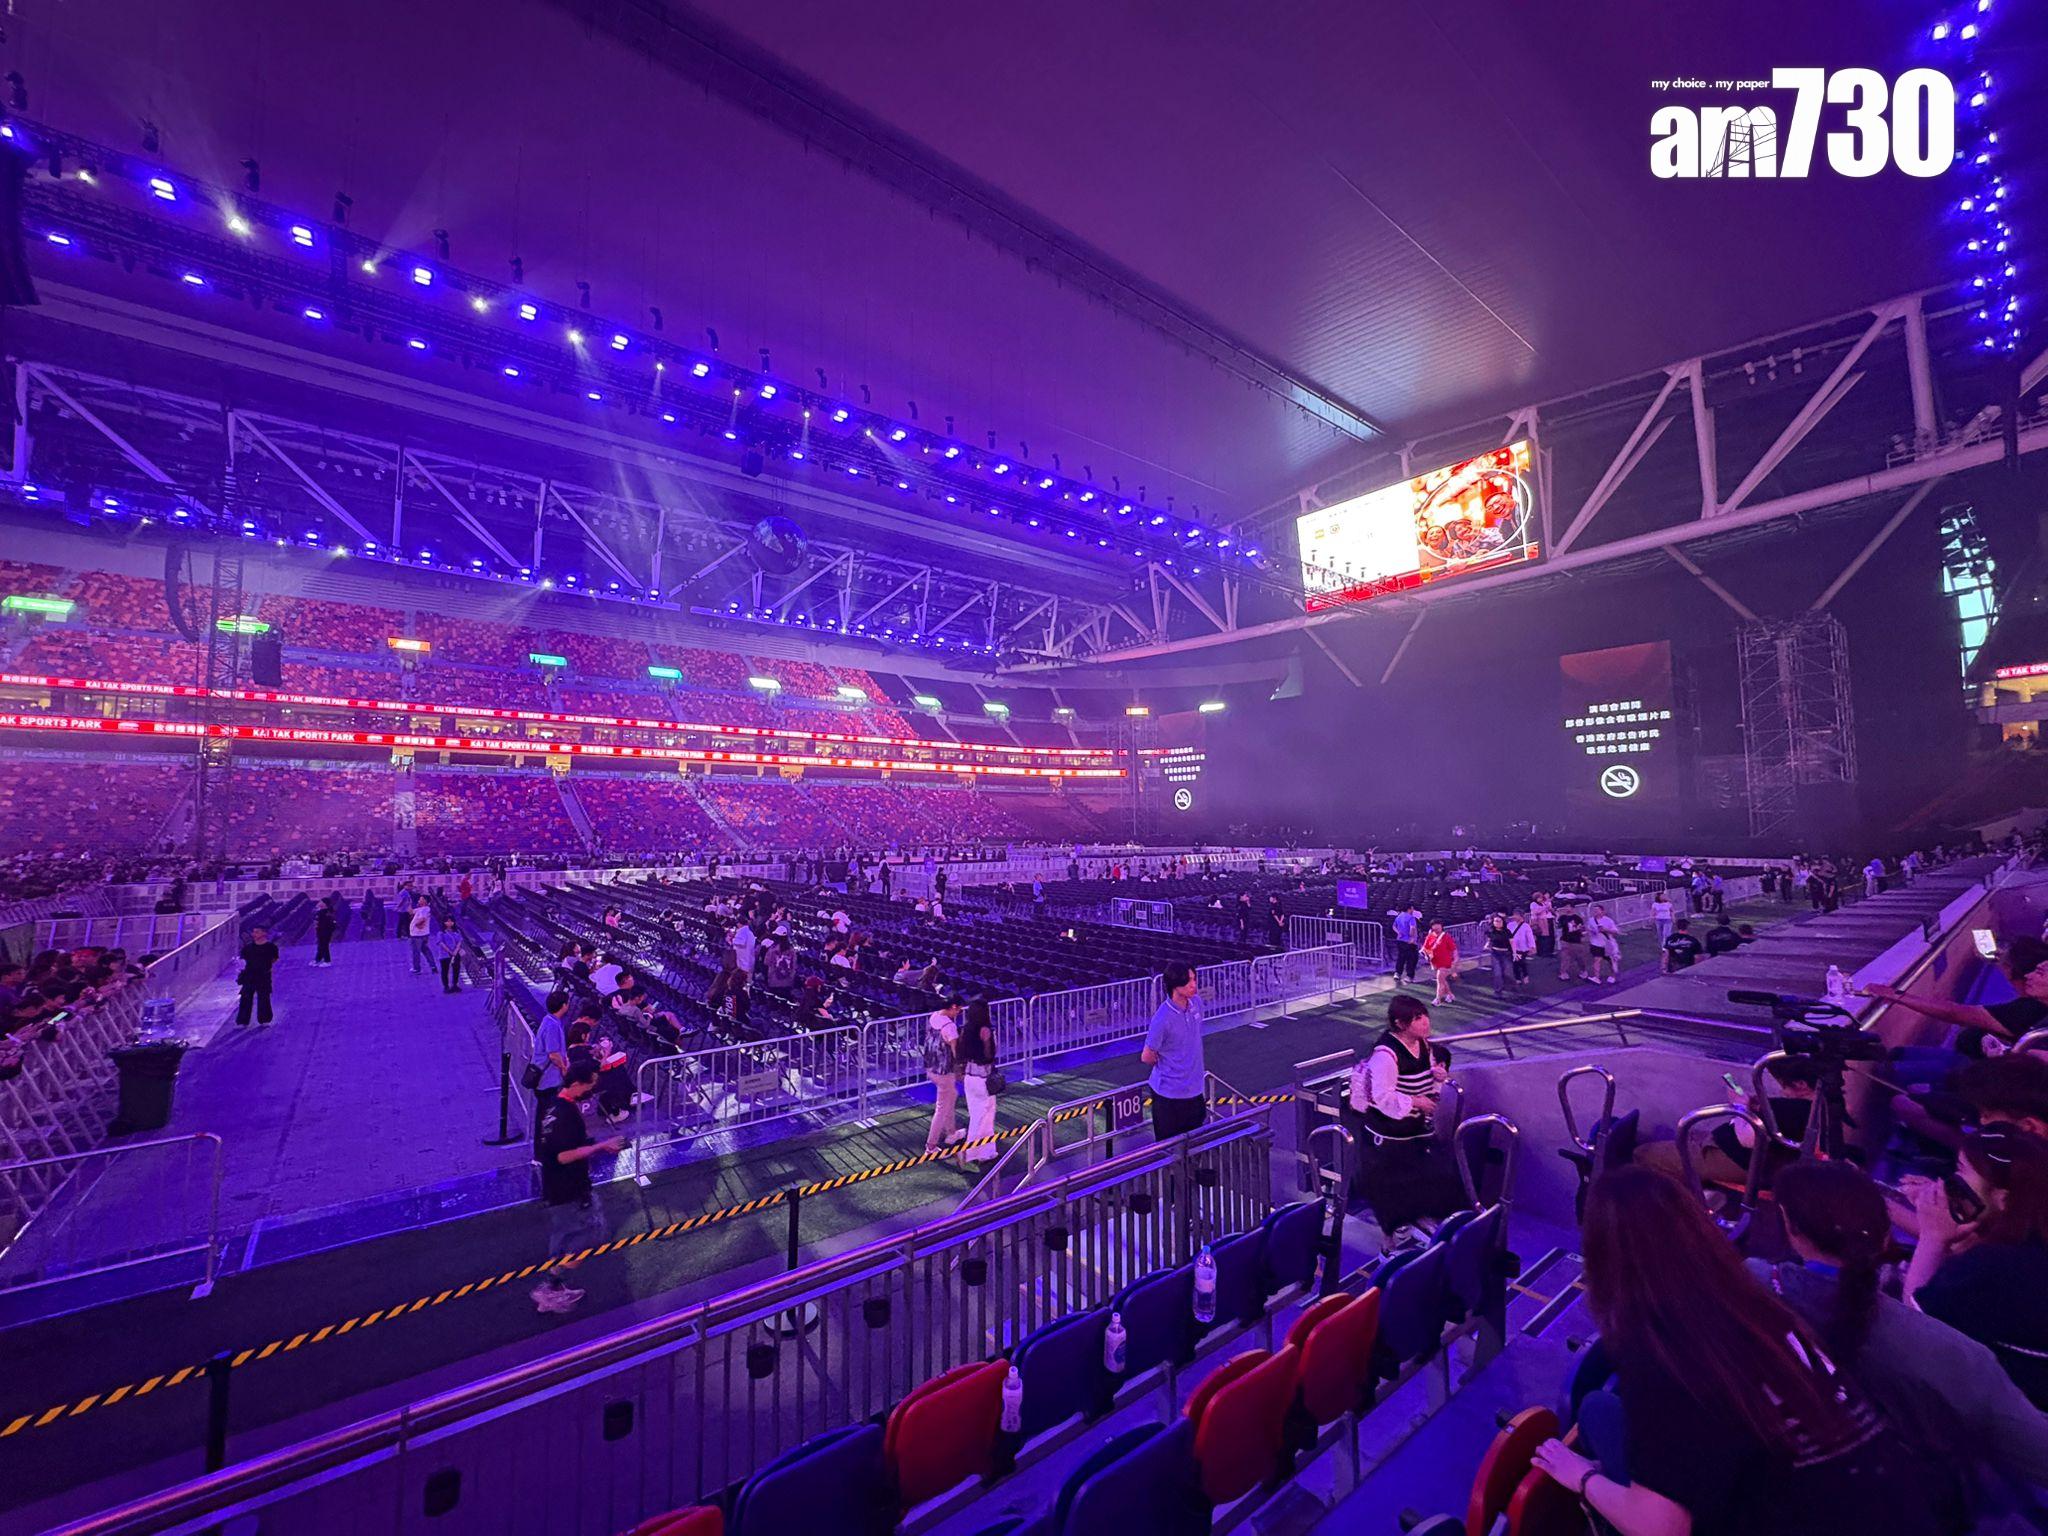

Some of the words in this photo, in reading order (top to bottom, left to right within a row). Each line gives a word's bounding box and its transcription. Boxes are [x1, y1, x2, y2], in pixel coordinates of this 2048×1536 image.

[2011, 667, 2028, 675] TAK
[86, 681, 100, 689] KAI
[103, 682, 118, 690] TAK
[121, 683, 152, 692] SPORTS
[154, 685, 174, 693] PARK
[276, 694, 289, 702] KAI
[291, 694, 304, 703] TAK
[305, 696, 331, 704] SPORTS
[332, 698, 349, 706] PARK
[20, 717, 69, 727] SPORTS
[70, 719, 102, 729] PARK
[253, 729, 270, 737] KAI
[272, 730, 290, 738] TAK
[293, 731, 329, 740] SPORTS
[331, 733, 355, 741] PARK
[486, 740, 500, 748] TAK
[501, 741, 530, 750] SPORTS
[532, 743, 550, 751] PARK
[1117, 1095, 1141, 1119] 108
